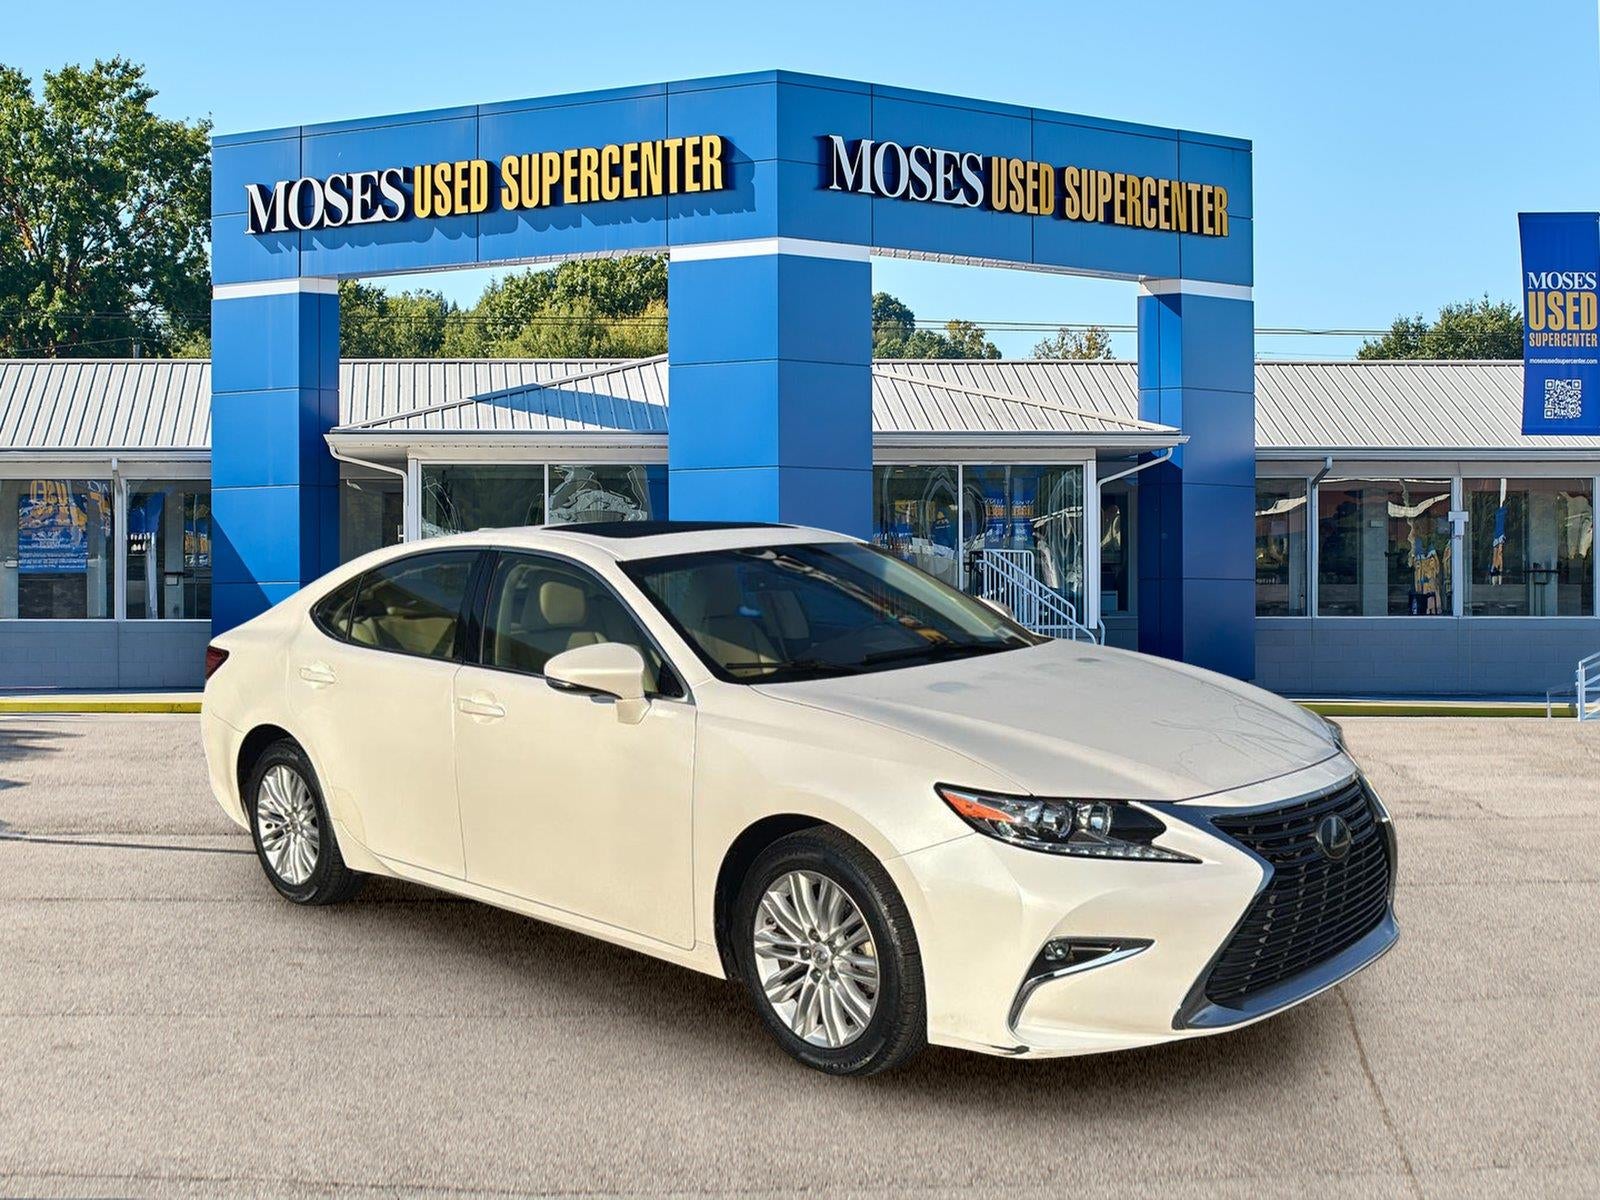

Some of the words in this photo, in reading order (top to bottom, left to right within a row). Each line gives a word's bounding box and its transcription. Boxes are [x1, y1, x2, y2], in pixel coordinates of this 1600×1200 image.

[245, 168, 408, 235] MOSES
[413, 159, 489, 218] USED
[501, 134, 725, 211] SUPERCENTER
[829, 134, 985, 208] MOSES
[991, 156, 1056, 217] USED
[1065, 167, 1230, 237] SUPERCENTER
[1527, 271, 1598, 290] MOSES
[1528, 291, 1598, 331] USED
[1529, 332, 1598, 347] SUPERCENTER
[1529, 357, 1598, 366] mosesusedsupercenter.com
